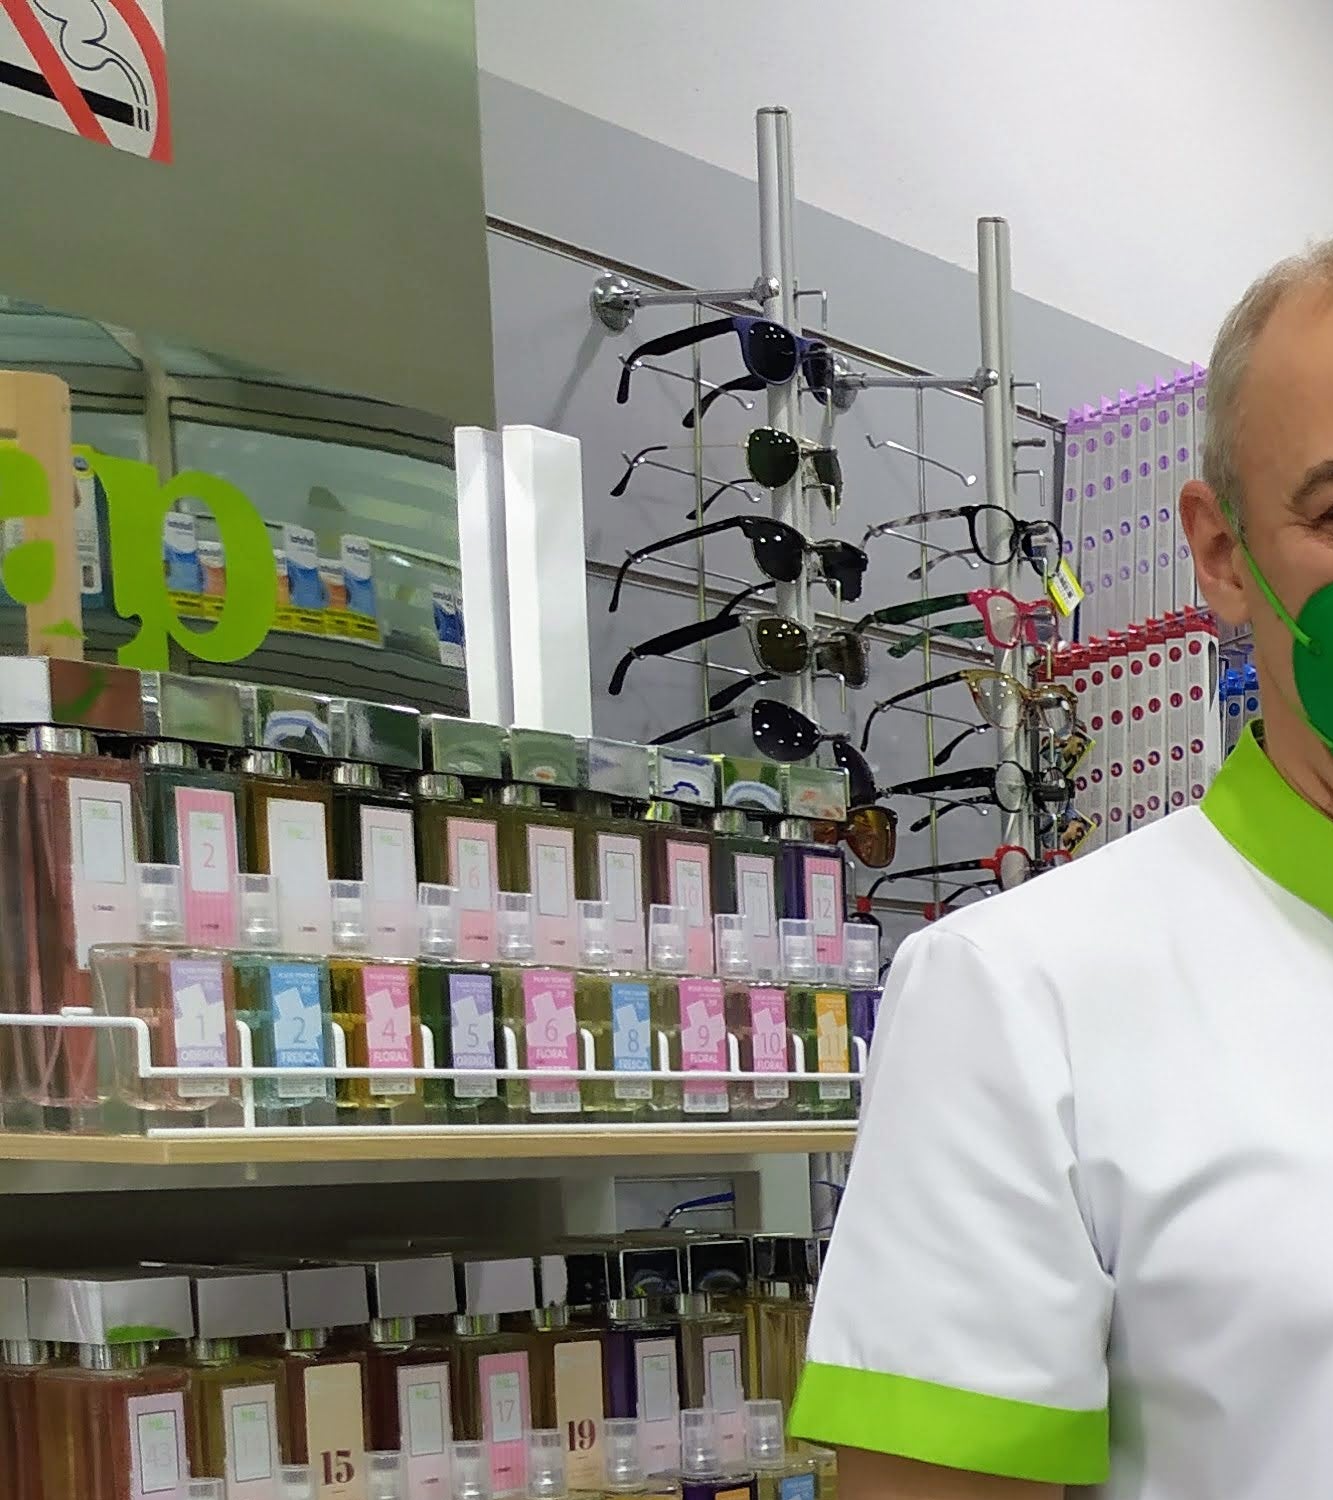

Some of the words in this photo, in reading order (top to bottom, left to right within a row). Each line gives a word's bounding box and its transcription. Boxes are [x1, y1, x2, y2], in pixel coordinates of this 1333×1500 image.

[202, 843, 217, 869] 2
[816, 895, 832, 920] 12
[292, 1016, 307, 1044] 2
[382, 1022, 397, 1044] 4
[466, 1023, 480, 1048] 5
[544, 1017, 558, 1042] 6
[627, 1028, 640, 1052] 8
[697, 1024, 710, 1047] 9
[535, 1047, 568, 1060] FLORAL
[760, 1033, 781, 1054] 10
[372, 1051, 409, 1064] FLORAL
[689, 1053, 719, 1064] FLORAL
[494, 1399, 515, 1423] 17
[567, 1418, 596, 1451] 19
[321, 1449, 355, 1486] 15
